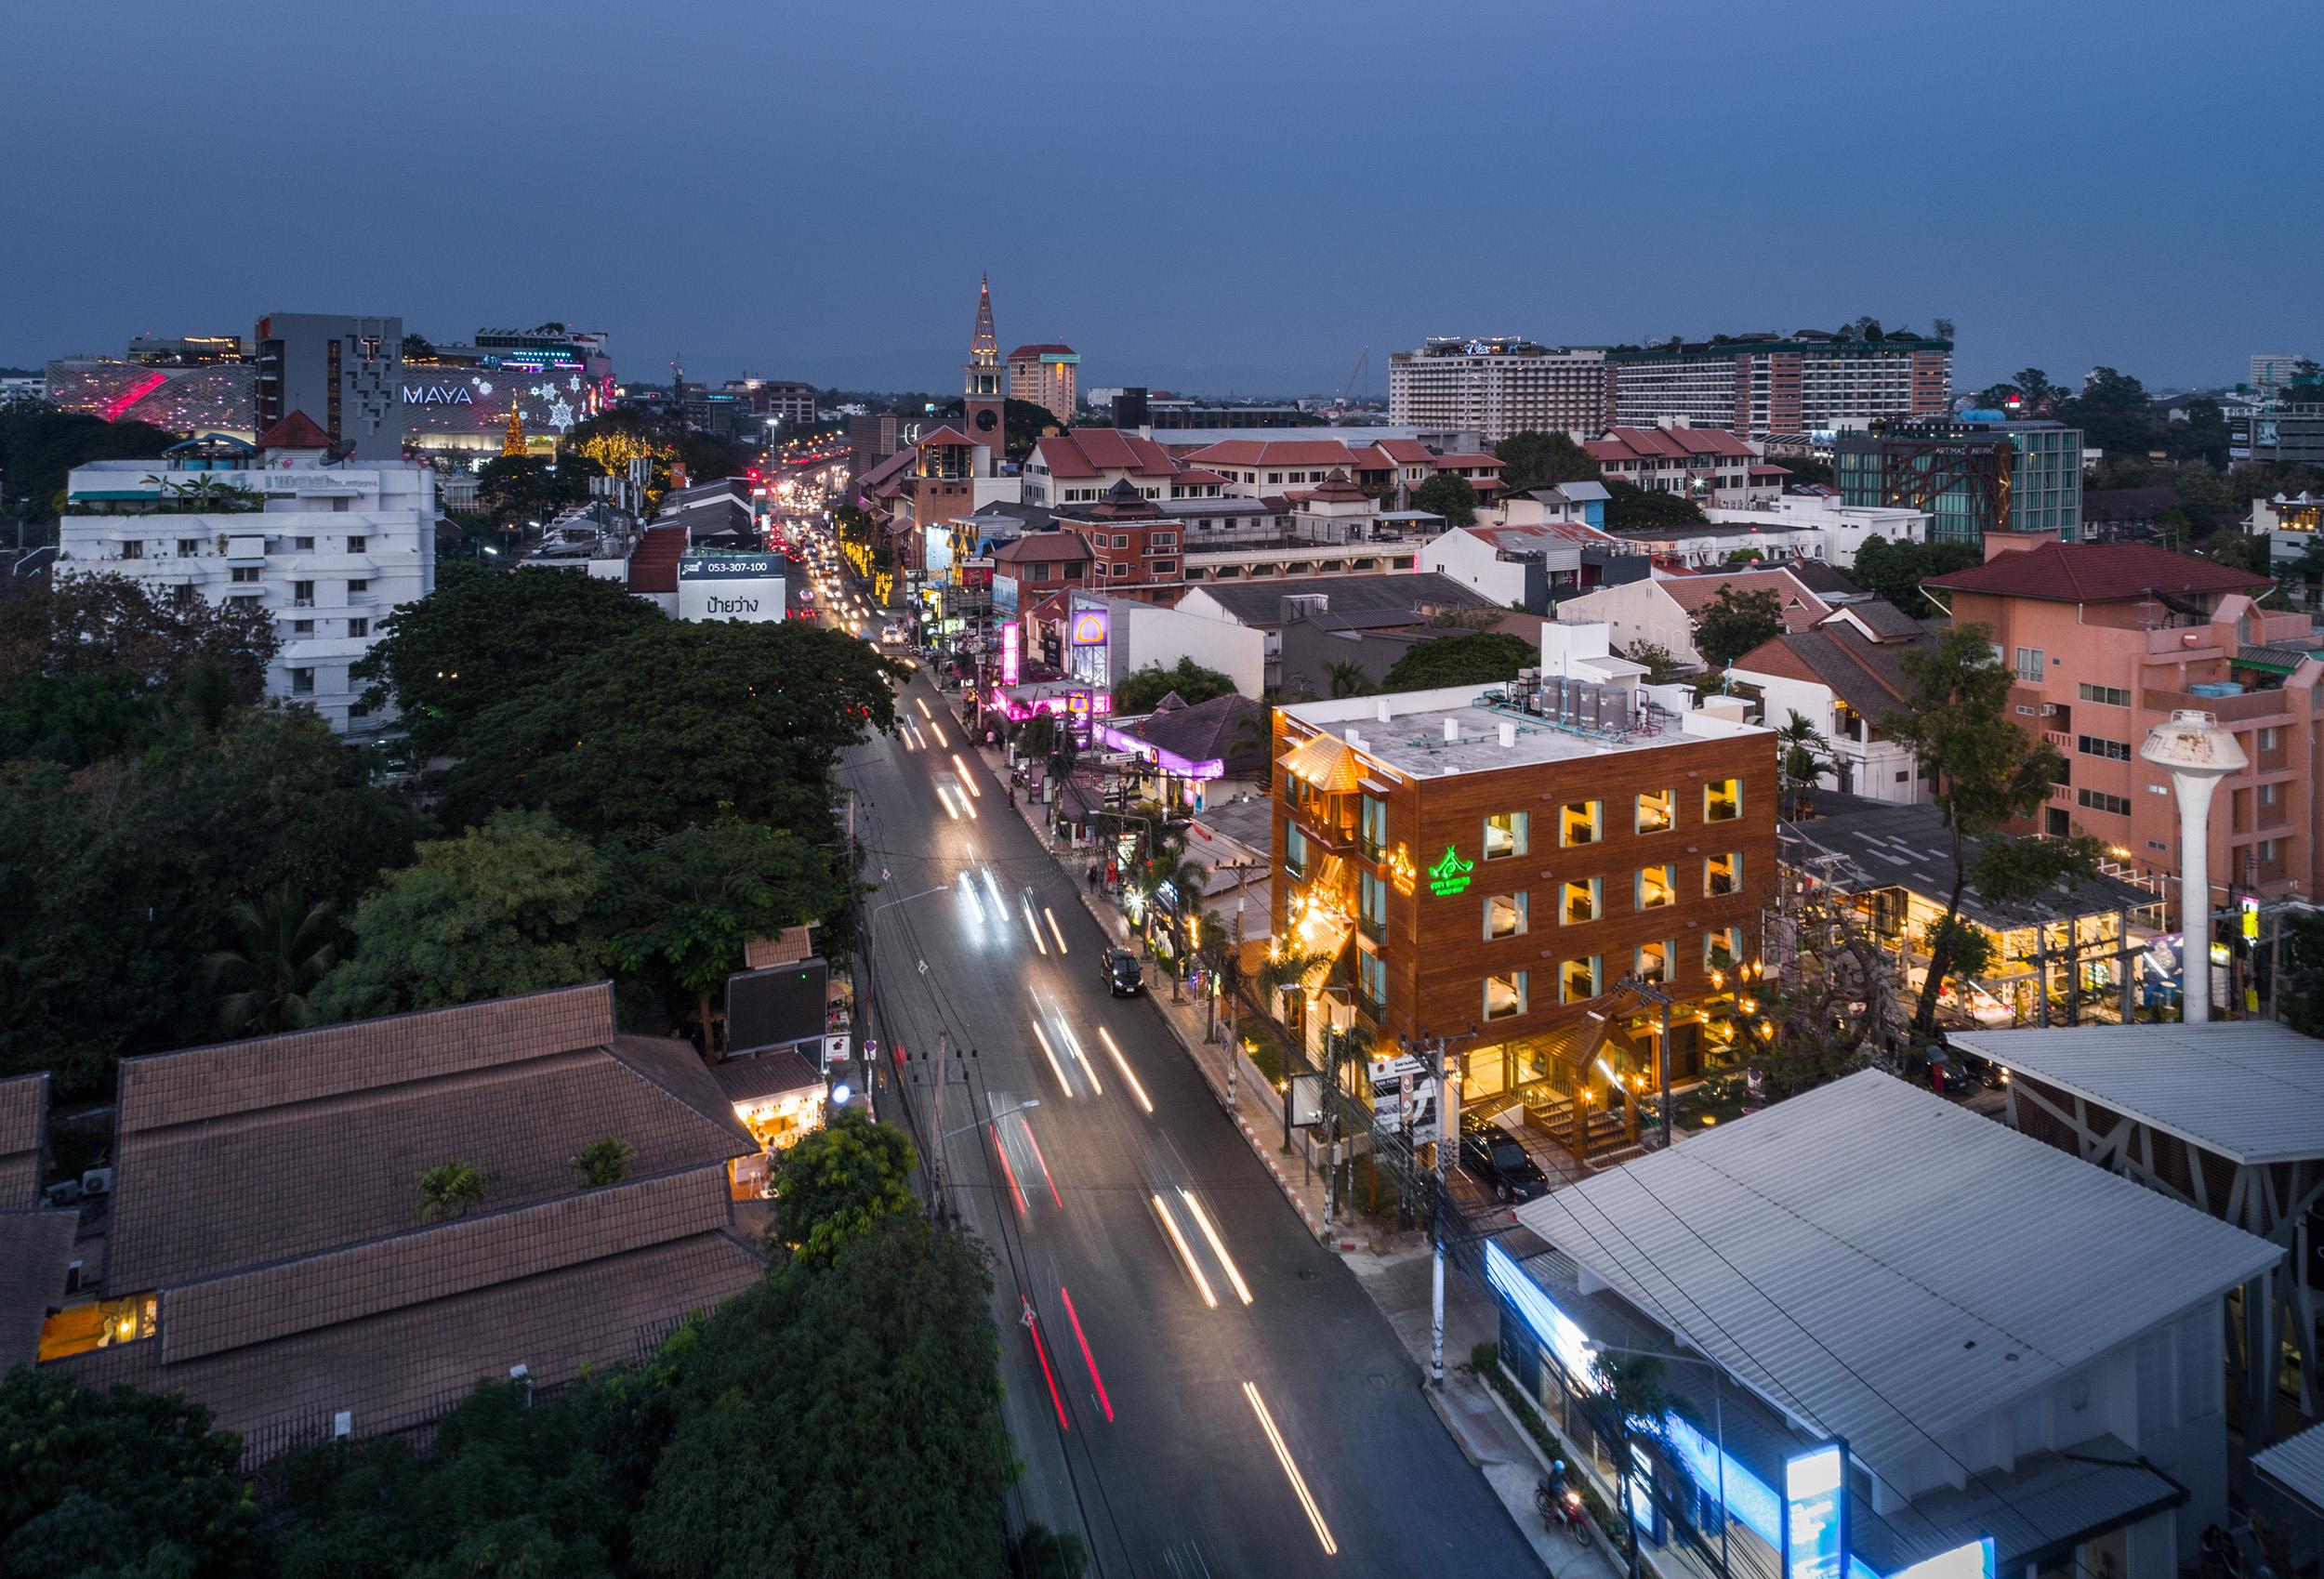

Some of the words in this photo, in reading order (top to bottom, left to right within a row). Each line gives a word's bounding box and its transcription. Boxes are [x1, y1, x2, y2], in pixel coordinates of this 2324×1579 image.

[403, 386, 472, 404] MAYA
[707, 562, 768, 572] 053-307-100
[706, 596, 759, 613] ป้ายว่าง
